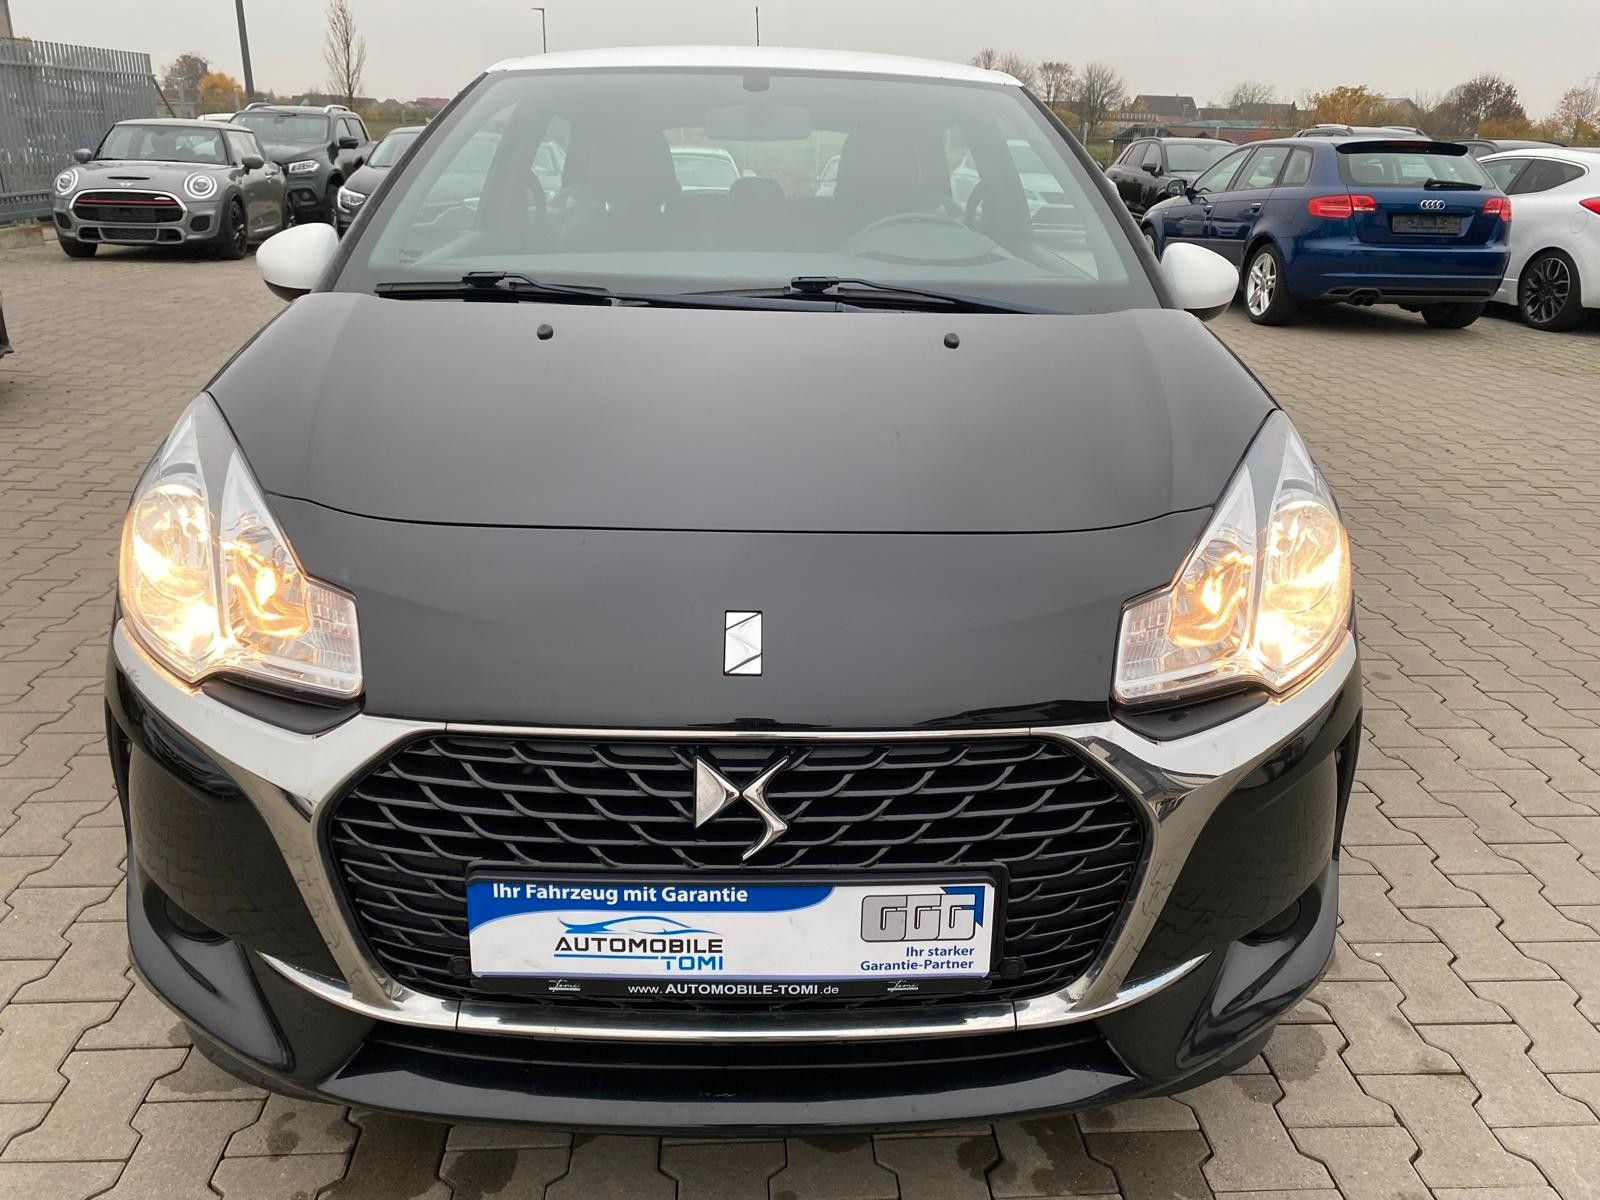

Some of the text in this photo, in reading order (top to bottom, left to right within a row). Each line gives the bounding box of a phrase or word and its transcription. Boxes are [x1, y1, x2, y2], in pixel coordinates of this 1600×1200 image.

[493, 883, 748, 905] Ihr Fahrzeug mit Garantie
[554, 937, 723, 954] AUTOMOBILE
[906, 946, 975, 957] Ihr starker
[660, 956, 723, 971] TOMI
[860, 959, 974, 972] Garantie-Partner
